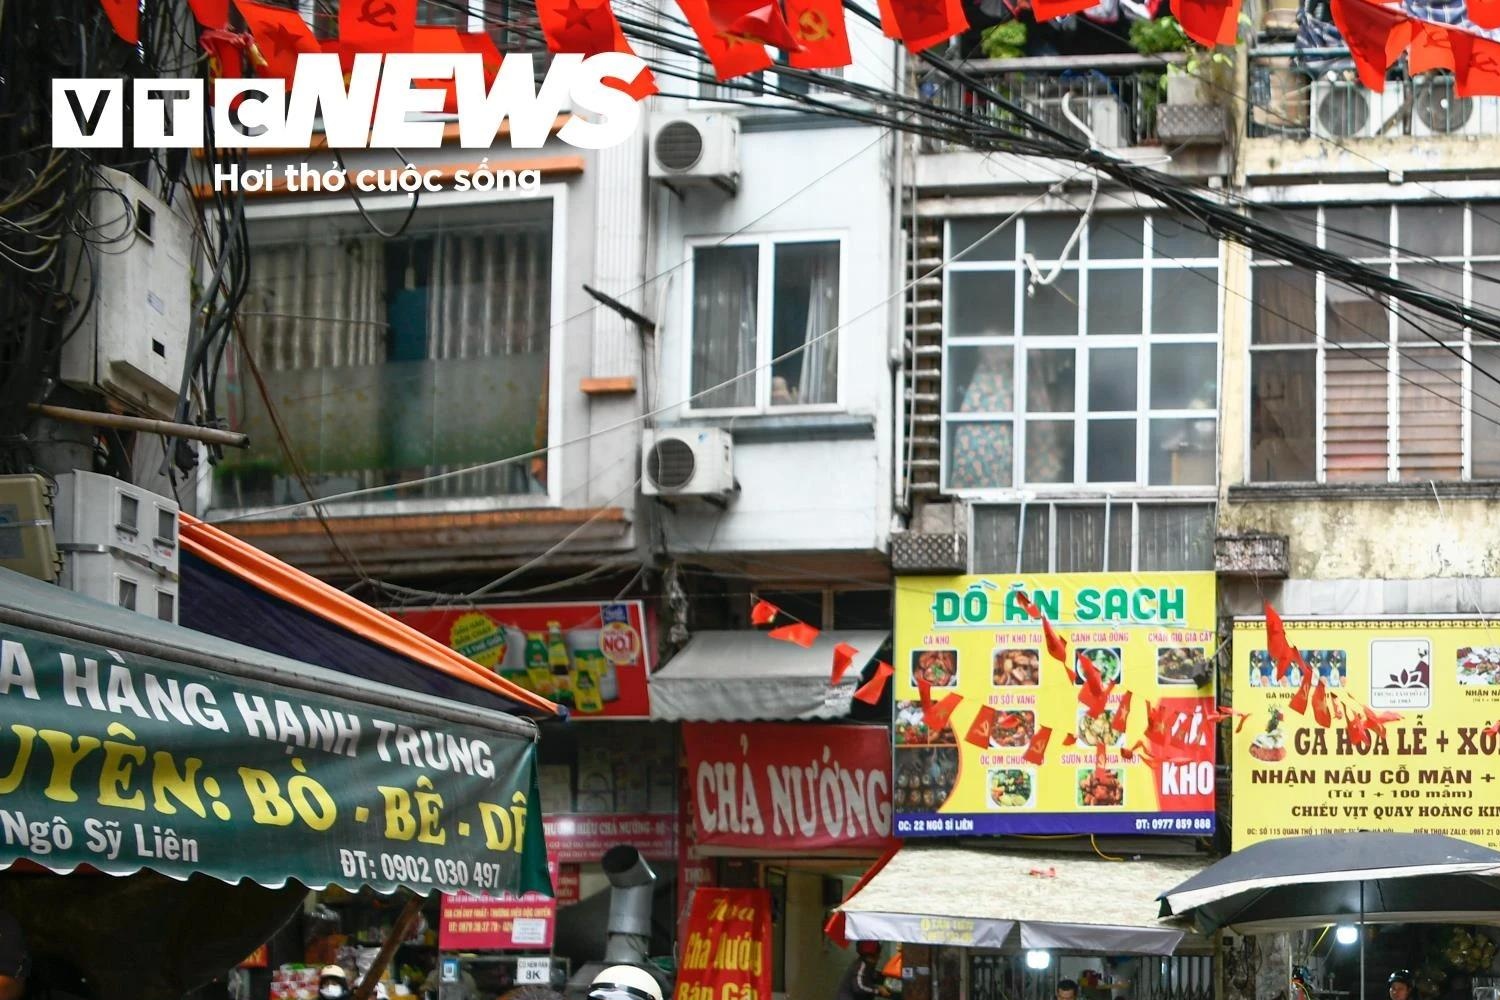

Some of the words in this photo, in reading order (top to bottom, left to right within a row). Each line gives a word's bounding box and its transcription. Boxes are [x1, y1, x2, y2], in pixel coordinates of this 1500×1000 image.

[60, 649, 229, 733] HÀNG
[233, 692, 361, 759] HẠNH
[363, 718, 496, 779] TRUNG
[1397, 715, 1427, 755] LỄ
[697, 734, 765, 835] CHẢ
[766, 746, 892, 838] NƯỚNG
[1162, 761, 1214, 795] KHO
[1252, 769, 1316, 787] NHẬN
[1324, 764, 1371, 784] NẤU
[1380, 764, 1409, 784] CỖ
[1418, 766, 1472, 787] MẶN
[1391, 789, 1420, 798] 100
[238, 758, 338, 832] BÒ
[377, 775, 446, 846] BÊ
[1373, 806, 1413, 819] QUAY
[1, 810, 73, 855] Ngô
[84, 818, 122, 860] Sỹ
[136, 822, 199, 863] Liên
[914, 820, 925, 830] 22
[340, 848, 377, 880] ĐT:
[380, 853, 432, 884] 0902
[435, 858, 469, 886] 030
[472, 861, 501, 889] 497
